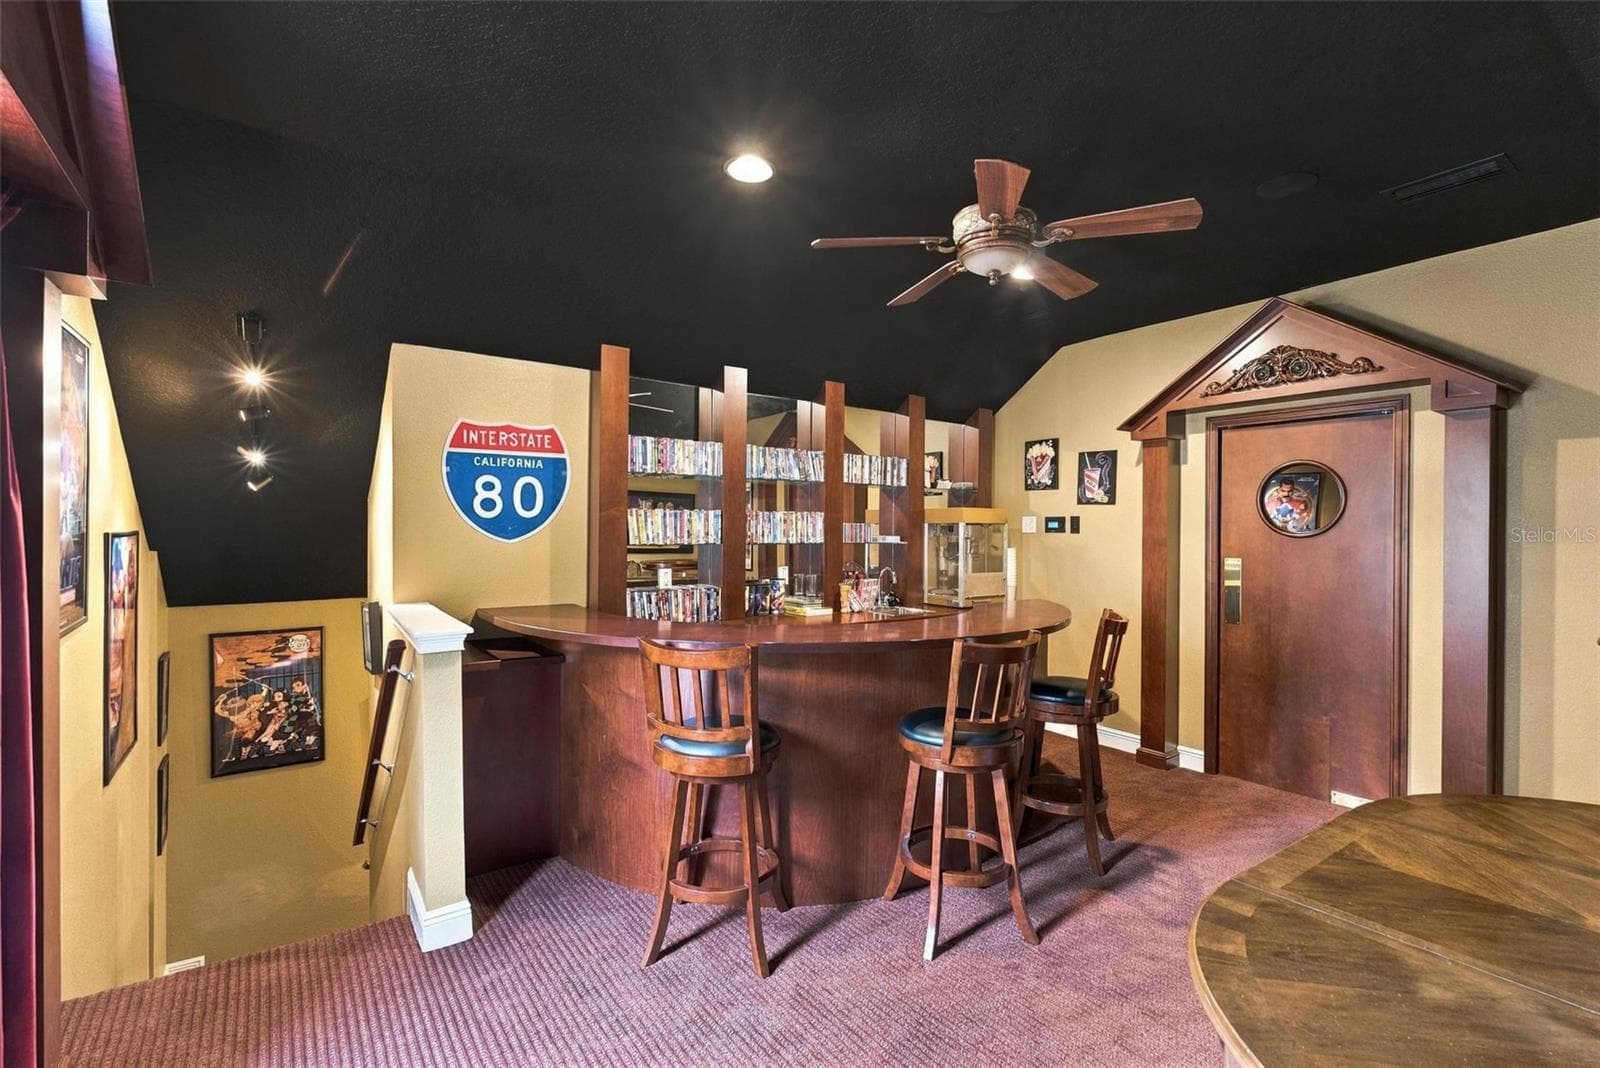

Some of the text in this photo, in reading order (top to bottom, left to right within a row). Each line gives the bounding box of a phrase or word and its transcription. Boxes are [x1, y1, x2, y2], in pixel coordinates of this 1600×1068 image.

[463, 429, 552, 448] INTERSTATE
[473, 456, 544, 469] CALIFORNIA
[472, 474, 544, 519] 80
